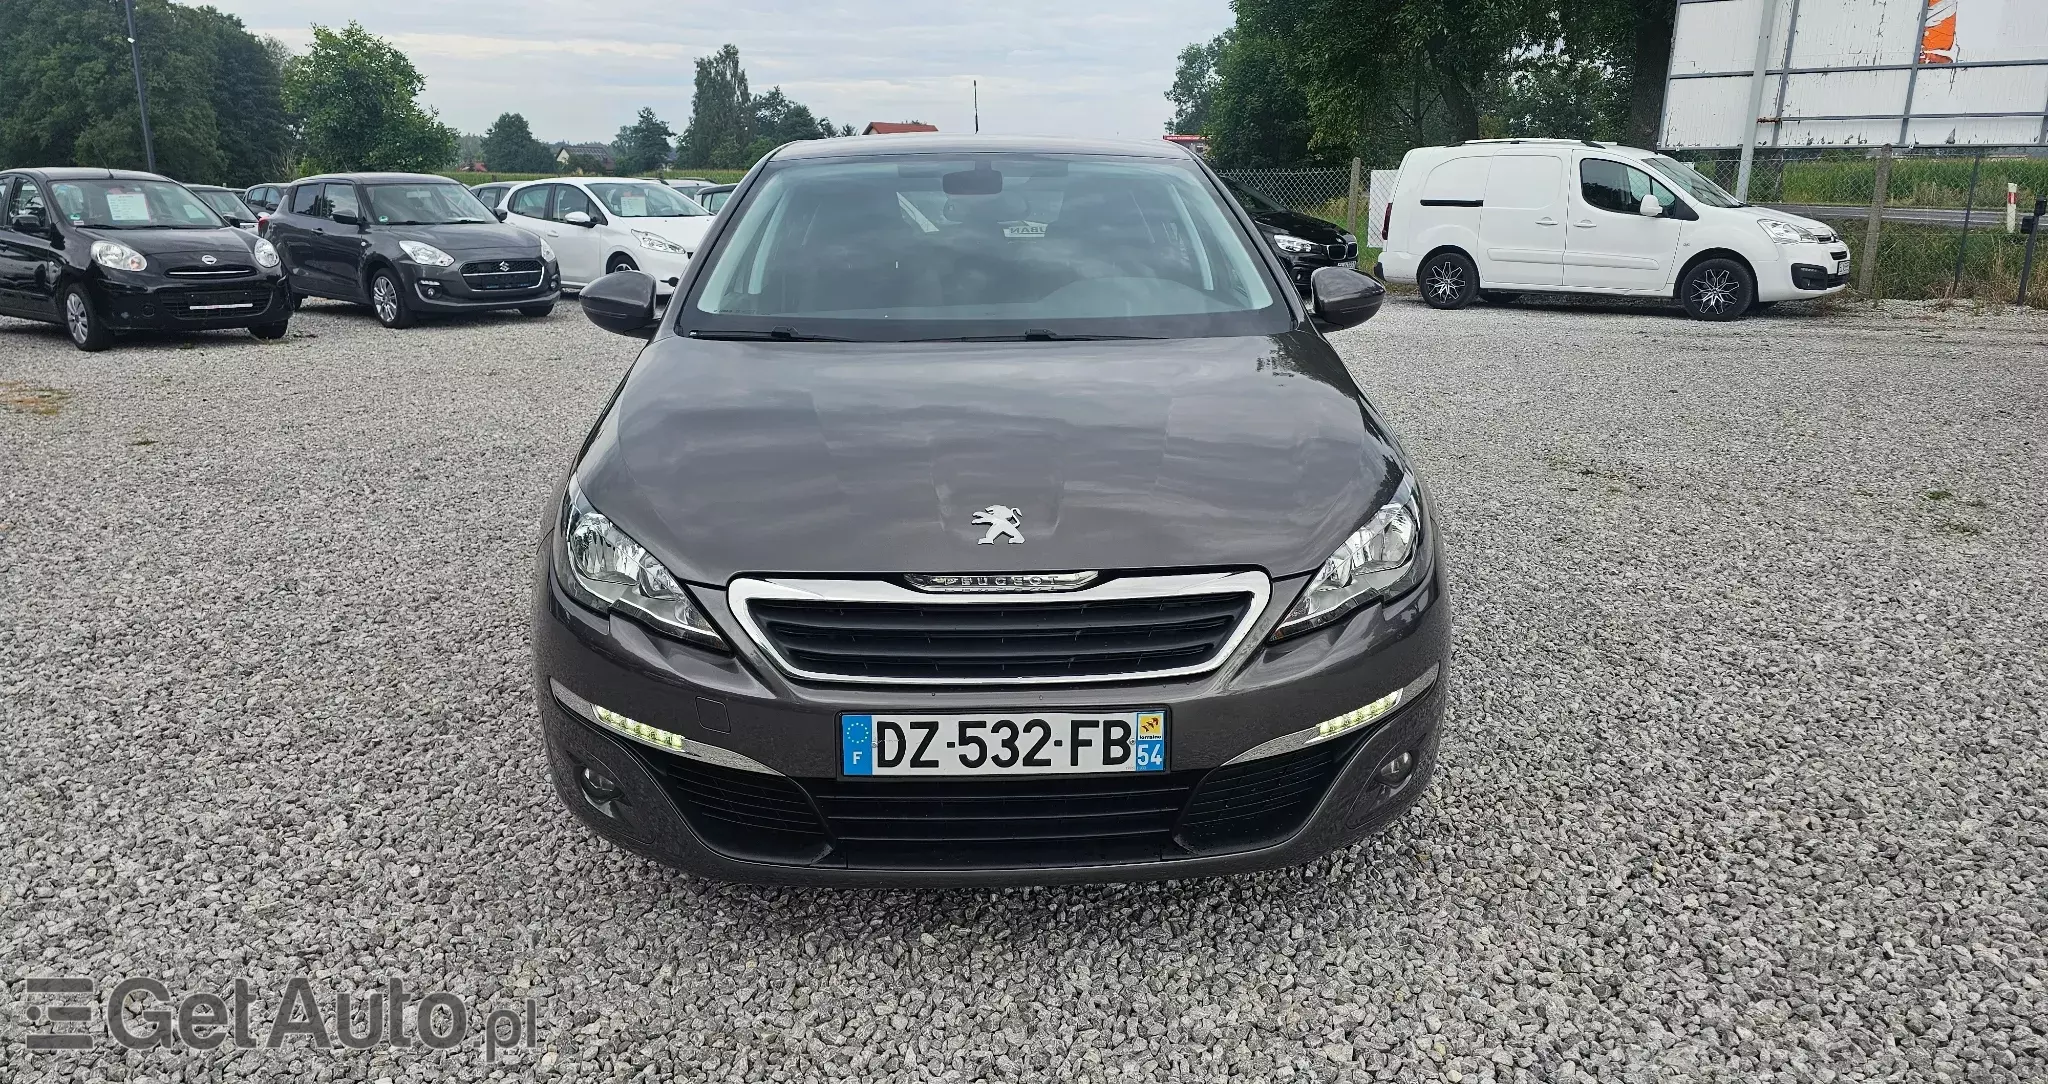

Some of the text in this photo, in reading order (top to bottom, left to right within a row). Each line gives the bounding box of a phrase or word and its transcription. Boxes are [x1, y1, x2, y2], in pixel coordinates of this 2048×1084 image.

[944, 576, 1059, 586] PEUGEOT
[876, 718, 1132, 769] DZ-532-FB
[853, 751, 863, 765] F
[1137, 743, 1163, 766] 54
